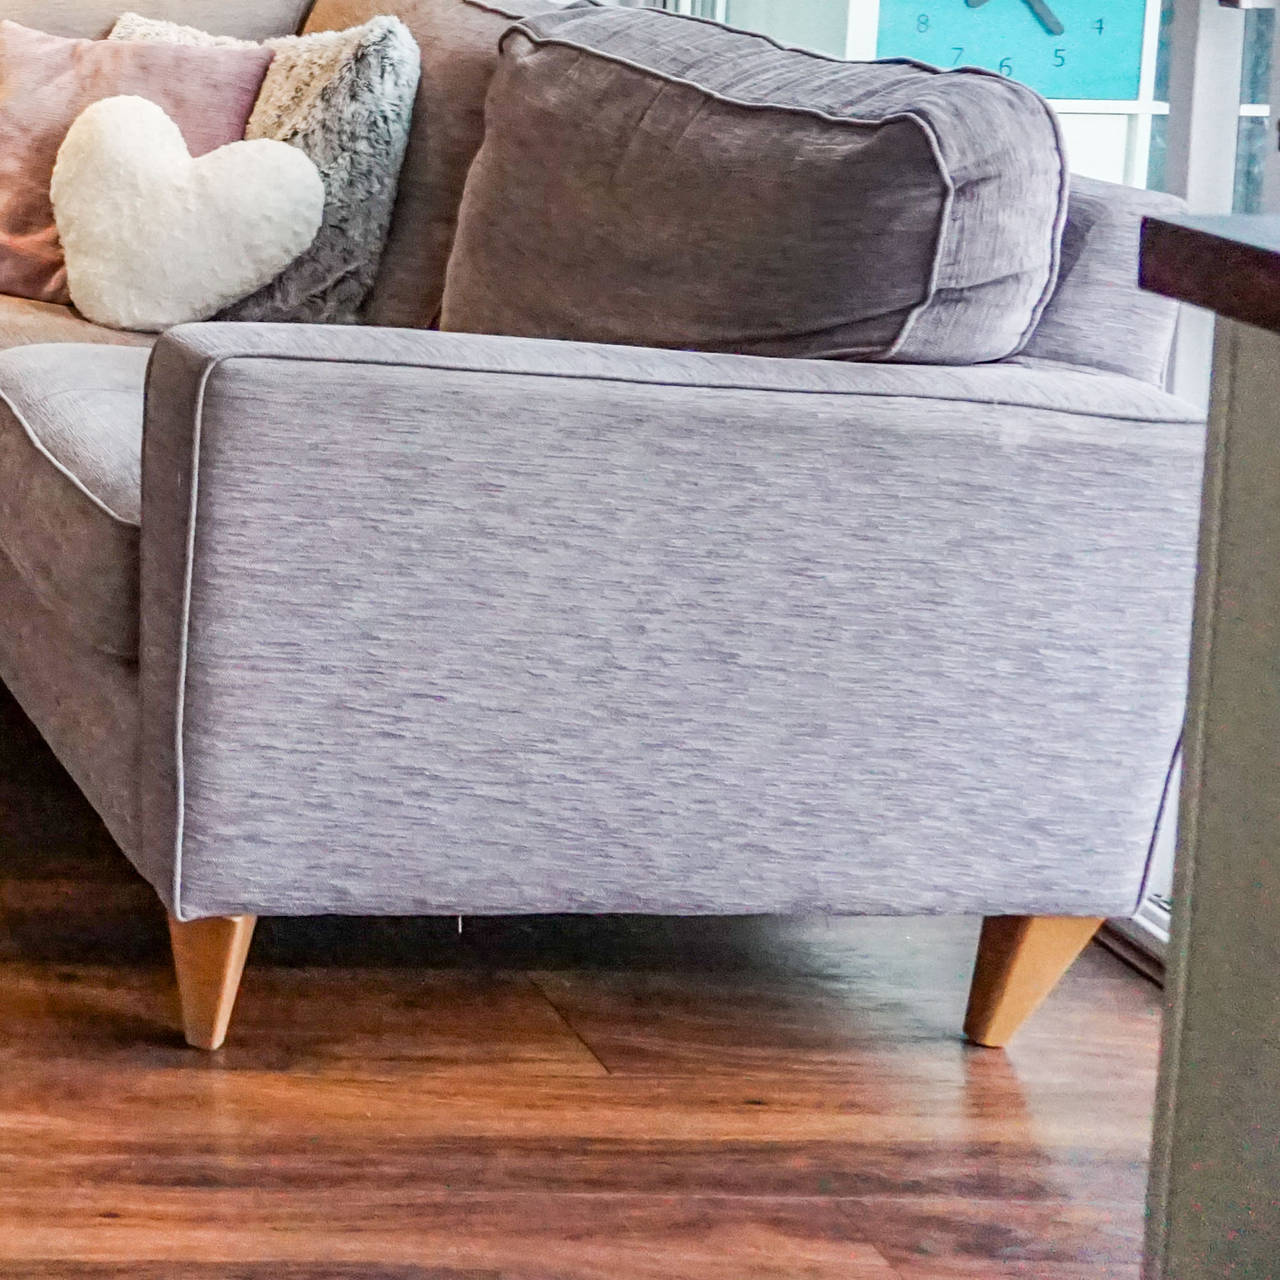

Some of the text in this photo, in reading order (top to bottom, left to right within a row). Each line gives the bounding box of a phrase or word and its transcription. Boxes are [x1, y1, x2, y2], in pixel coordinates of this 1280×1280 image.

[915, 13, 930, 34] 8
[1091, 17, 1105, 36] 4
[951, 47, 965, 66] 7
[1052, 48, 1066, 68] 5
[998, 56, 1013, 78] 6
